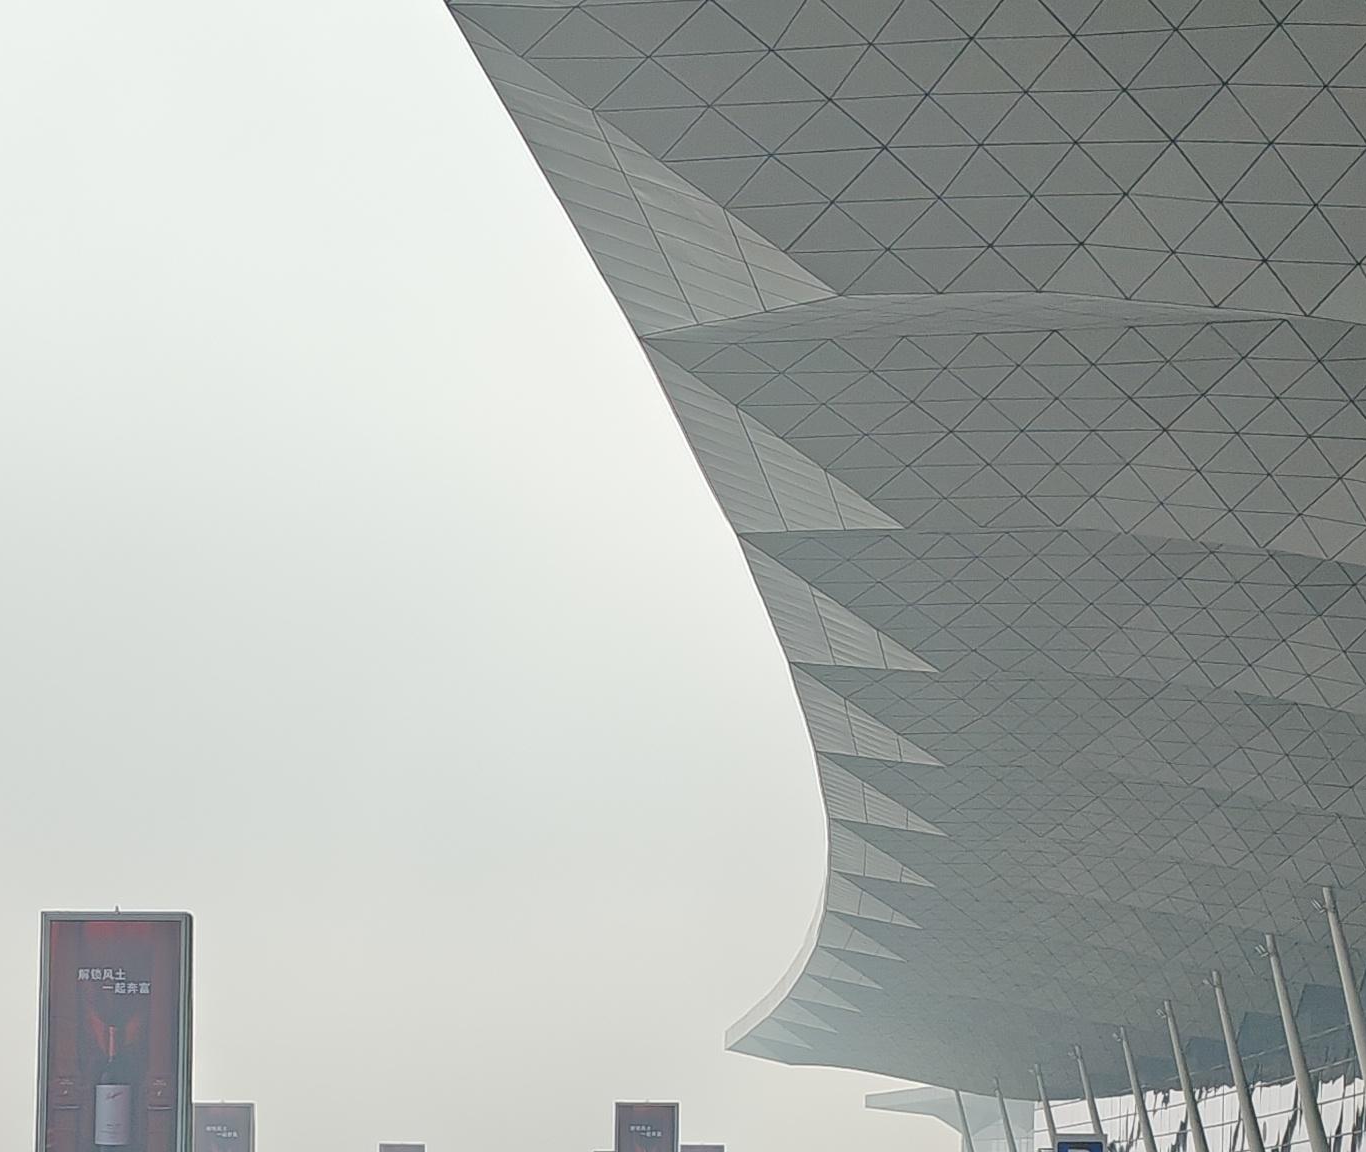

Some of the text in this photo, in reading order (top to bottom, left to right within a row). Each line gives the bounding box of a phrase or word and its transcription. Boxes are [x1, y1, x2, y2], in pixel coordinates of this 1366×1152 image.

[78, 968, 126, 980] 解锁风土
[102, 982, 150, 994] 一起奔富
